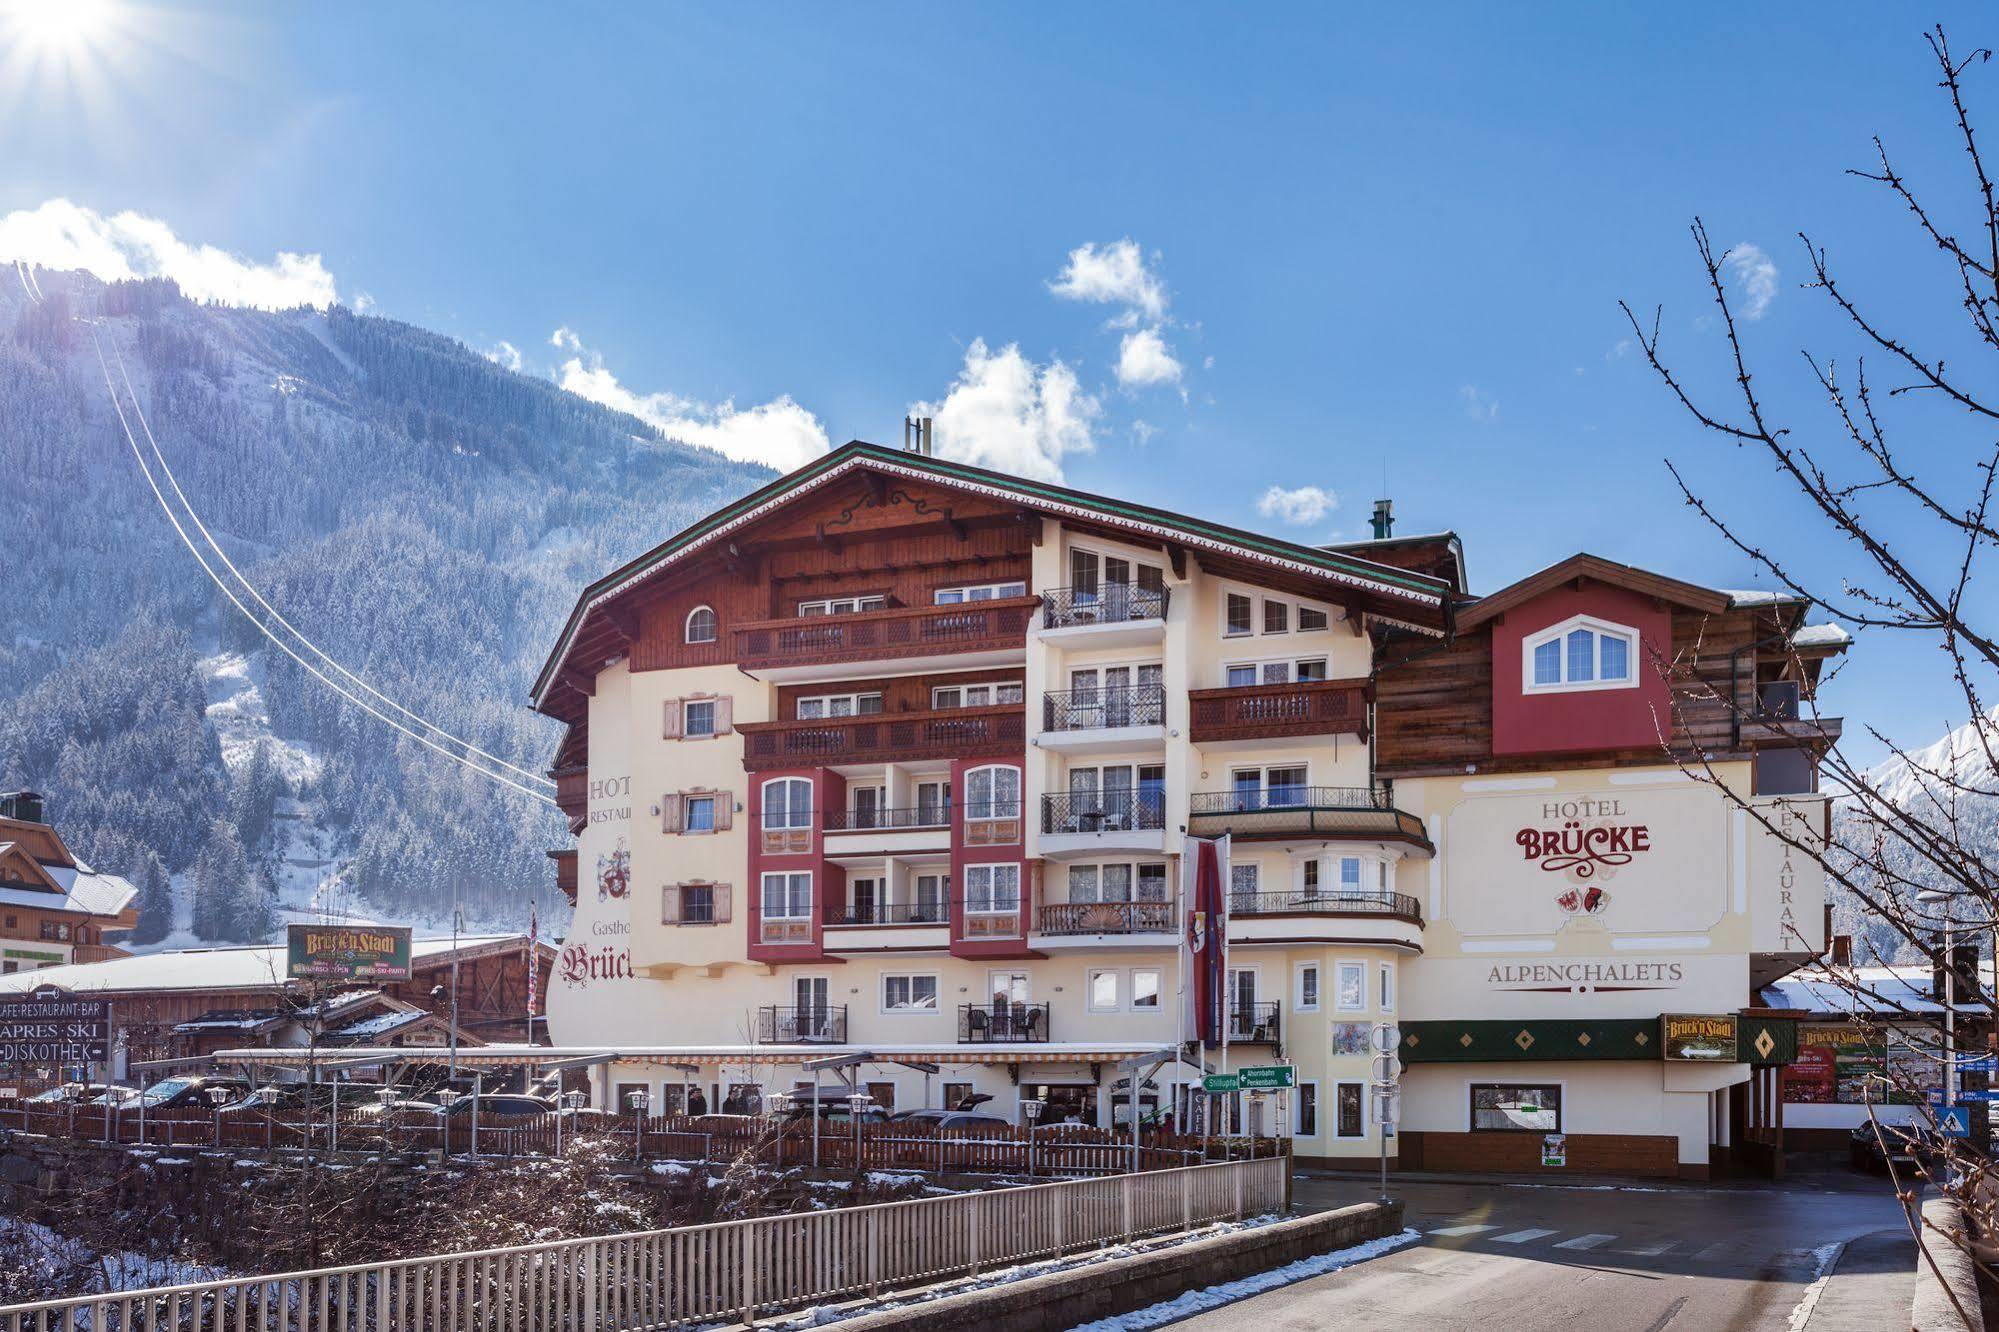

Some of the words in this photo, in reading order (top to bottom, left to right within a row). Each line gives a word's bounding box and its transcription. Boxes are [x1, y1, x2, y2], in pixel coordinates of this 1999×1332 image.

[1542, 799, 1626, 819] HOTEL
[1515, 821, 1651, 870] BRÜCKE
[1779, 799, 1795, 950] RESTAURANT
[1487, 962, 1683, 983] ALPENCHALETS
[0, 1024, 58, 1038] APRES
[67, 1024, 98, 1037] SKI
[1670, 1020, 1705, 1038] Brück'n
[1705, 1020, 1731, 1037] Stadl
[4, 1043, 91, 1060] DISKOTHEK
[1247, 1069, 1275, 1077] Ahornbahn
[1246, 1079, 1278, 1087] Penkenbahn
